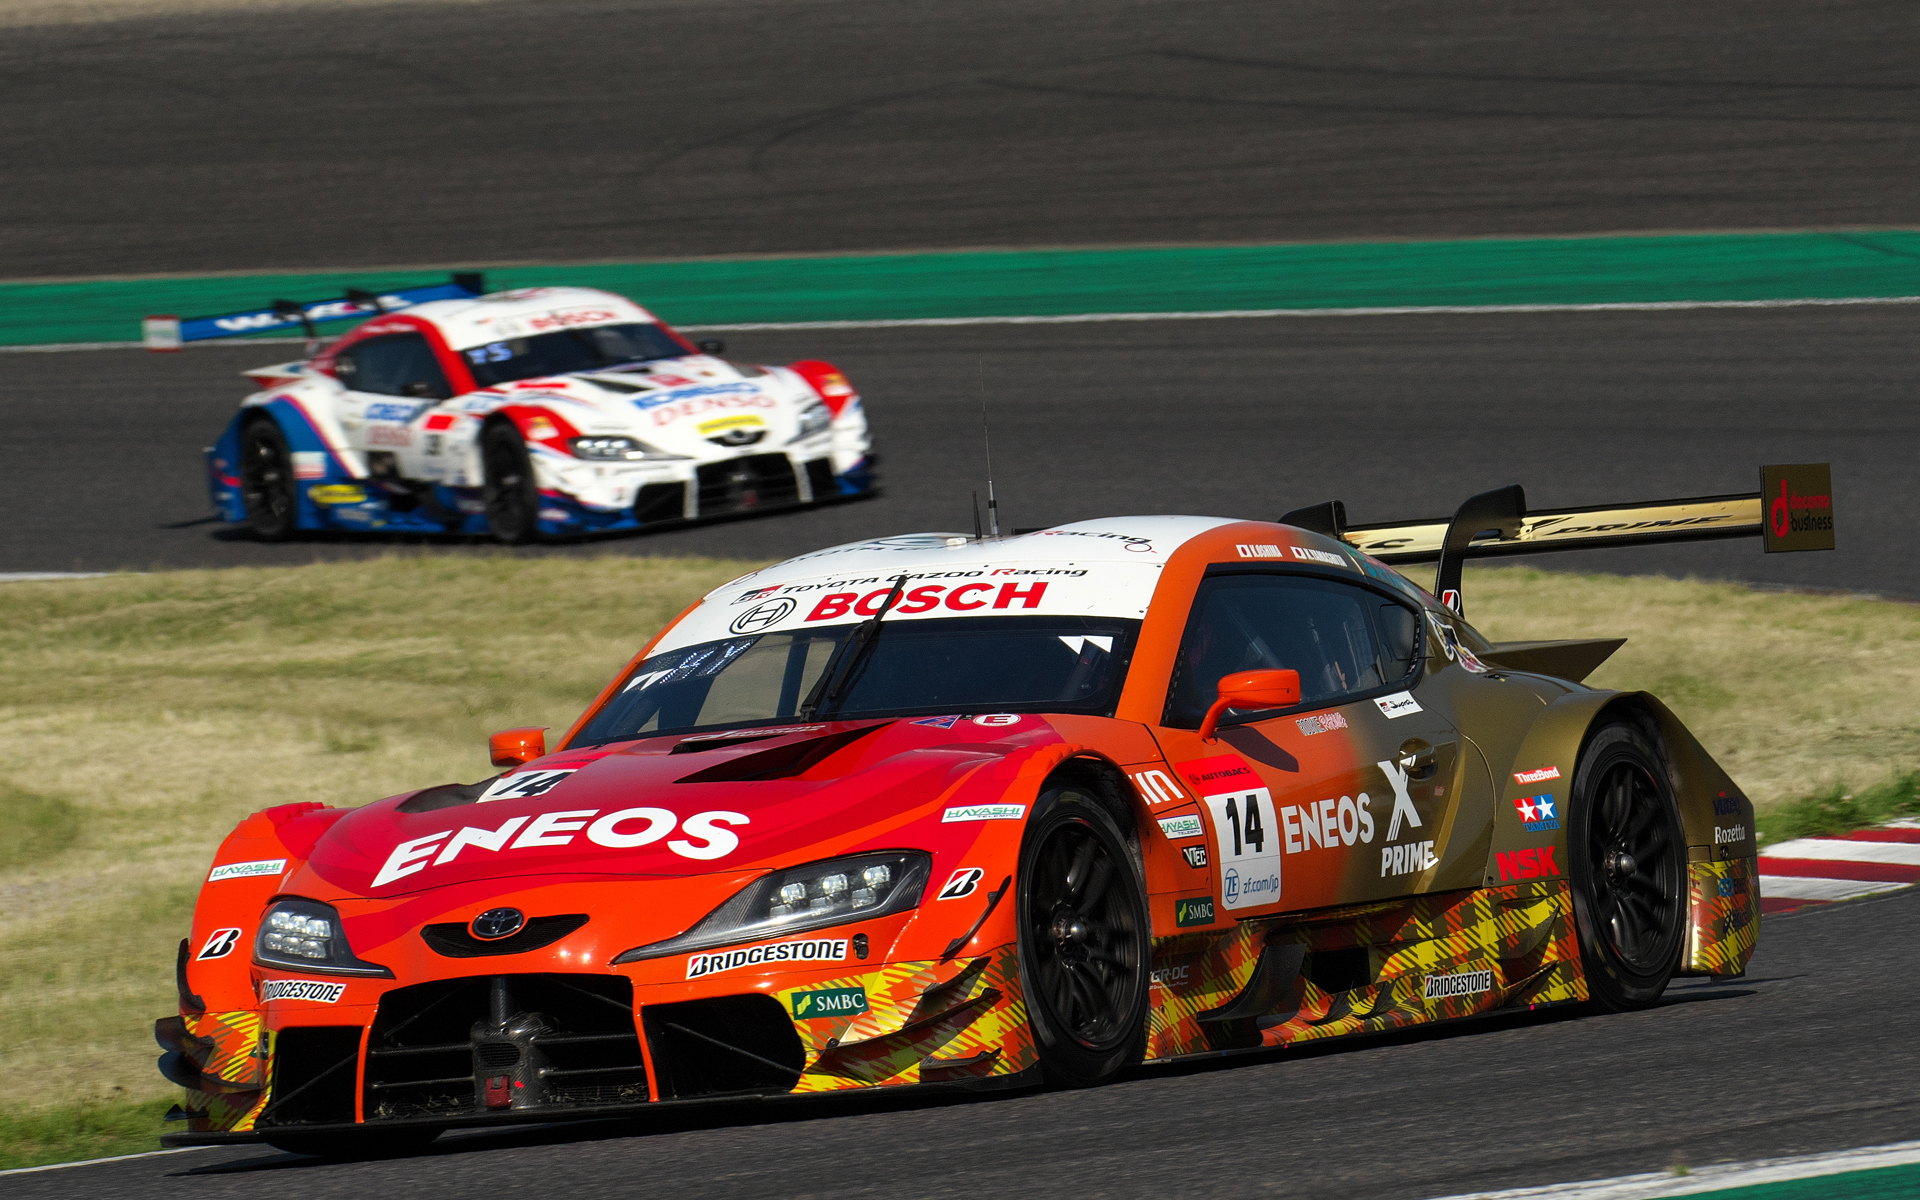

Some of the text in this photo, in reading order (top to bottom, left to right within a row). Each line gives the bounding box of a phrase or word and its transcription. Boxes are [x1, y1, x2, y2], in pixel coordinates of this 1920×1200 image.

[1791, 508, 1833, 532] business
[782, 568, 1089, 594] TOYOTA GAZOO Racing
[804, 582, 1049, 622] BOSCH
[491, 771, 575, 797] 14
[1201, 767, 1251, 782] AUTOBACS
[1514, 766, 1561, 783] ThreeBond
[946, 807, 1021, 818] HAYASHI
[1225, 793, 1265, 856] 14
[1280, 792, 1375, 855] ENEOS
[1523, 819, 1561, 833] TAMIYA
[1714, 823, 1746, 844] Rozetta
[370, 806, 752, 888] ENEOS
[1381, 840, 1440, 878] PRIME
[212, 862, 281, 878] HAYASHI
[1495, 845, 1561, 882] NSK
[1243, 873, 1279, 894] zf.com/jp
[1188, 902, 1213, 920] SMBC
[689, 941, 845, 978] BRIDGESTONE
[262, 981, 343, 1001] BRIDGESTONE
[1425, 972, 1490, 998] BRIDGESTONE
[816, 993, 865, 1012] SMBC
